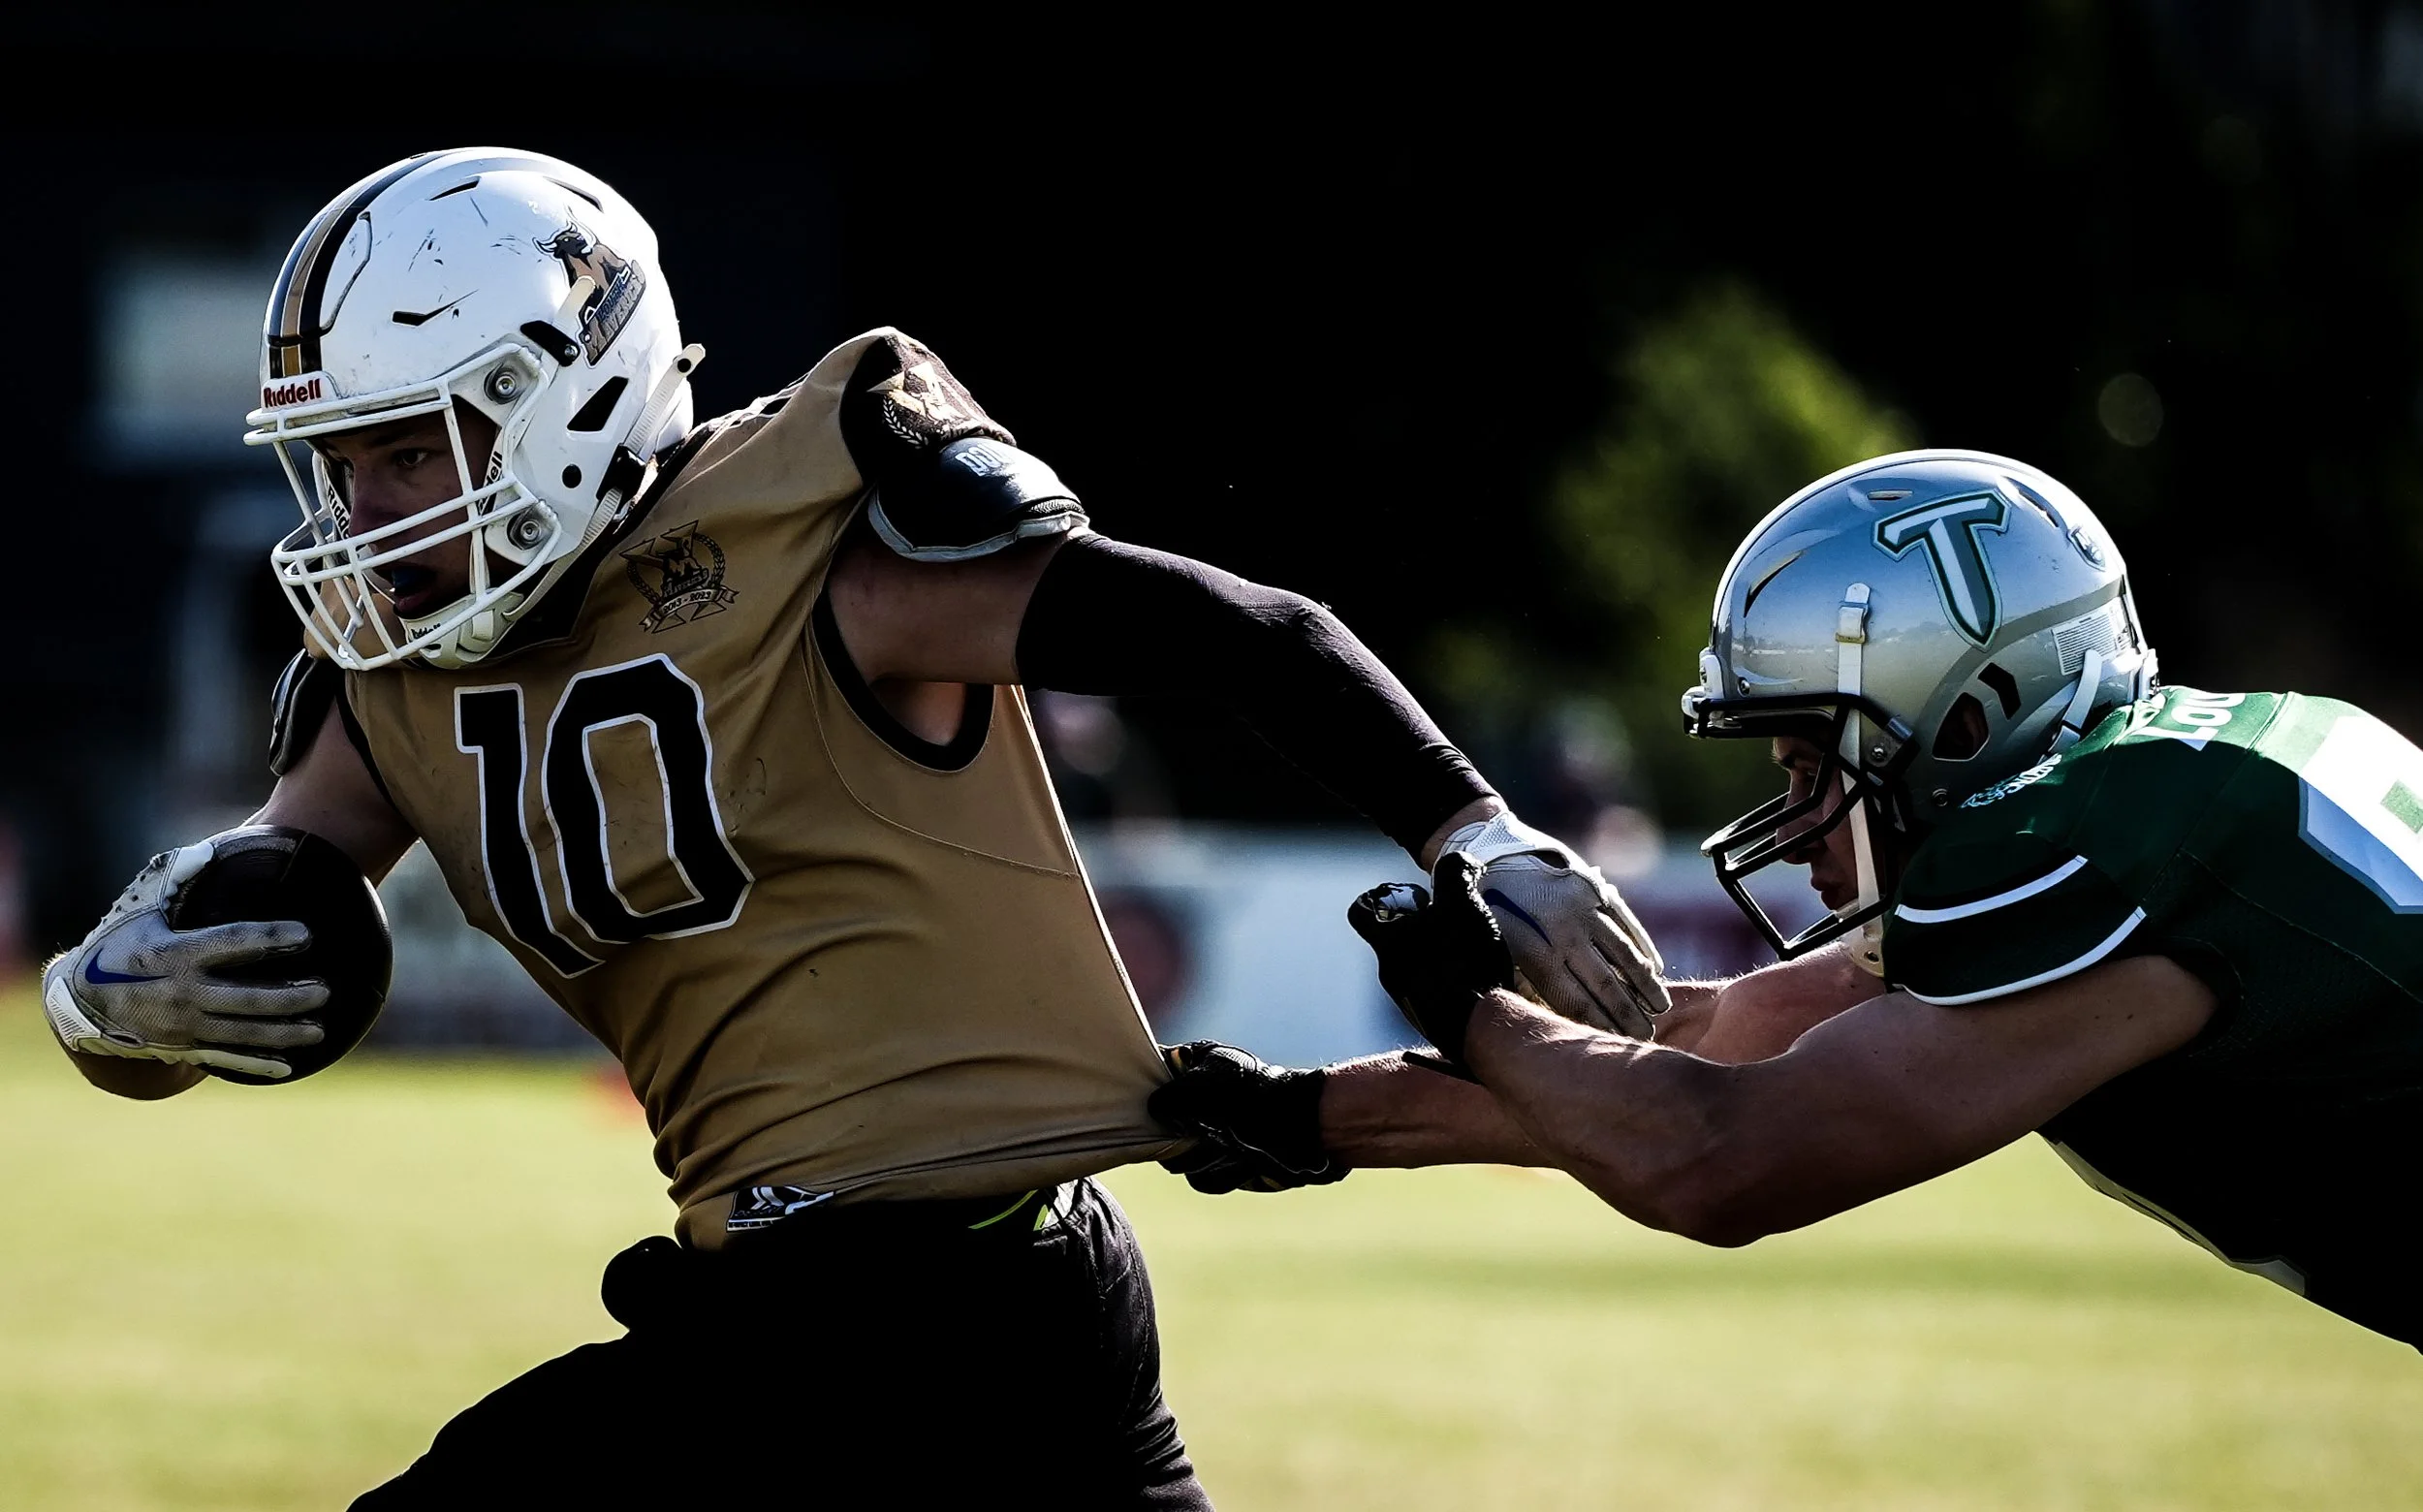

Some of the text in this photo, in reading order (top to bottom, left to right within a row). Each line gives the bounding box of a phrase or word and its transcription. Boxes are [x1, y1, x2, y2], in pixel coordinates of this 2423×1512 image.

[264, 379, 322, 408] Riddell
[663, 598, 681, 614] 2013
[690, 591, 711, 602] 2023
[455, 651, 755, 979] 10
